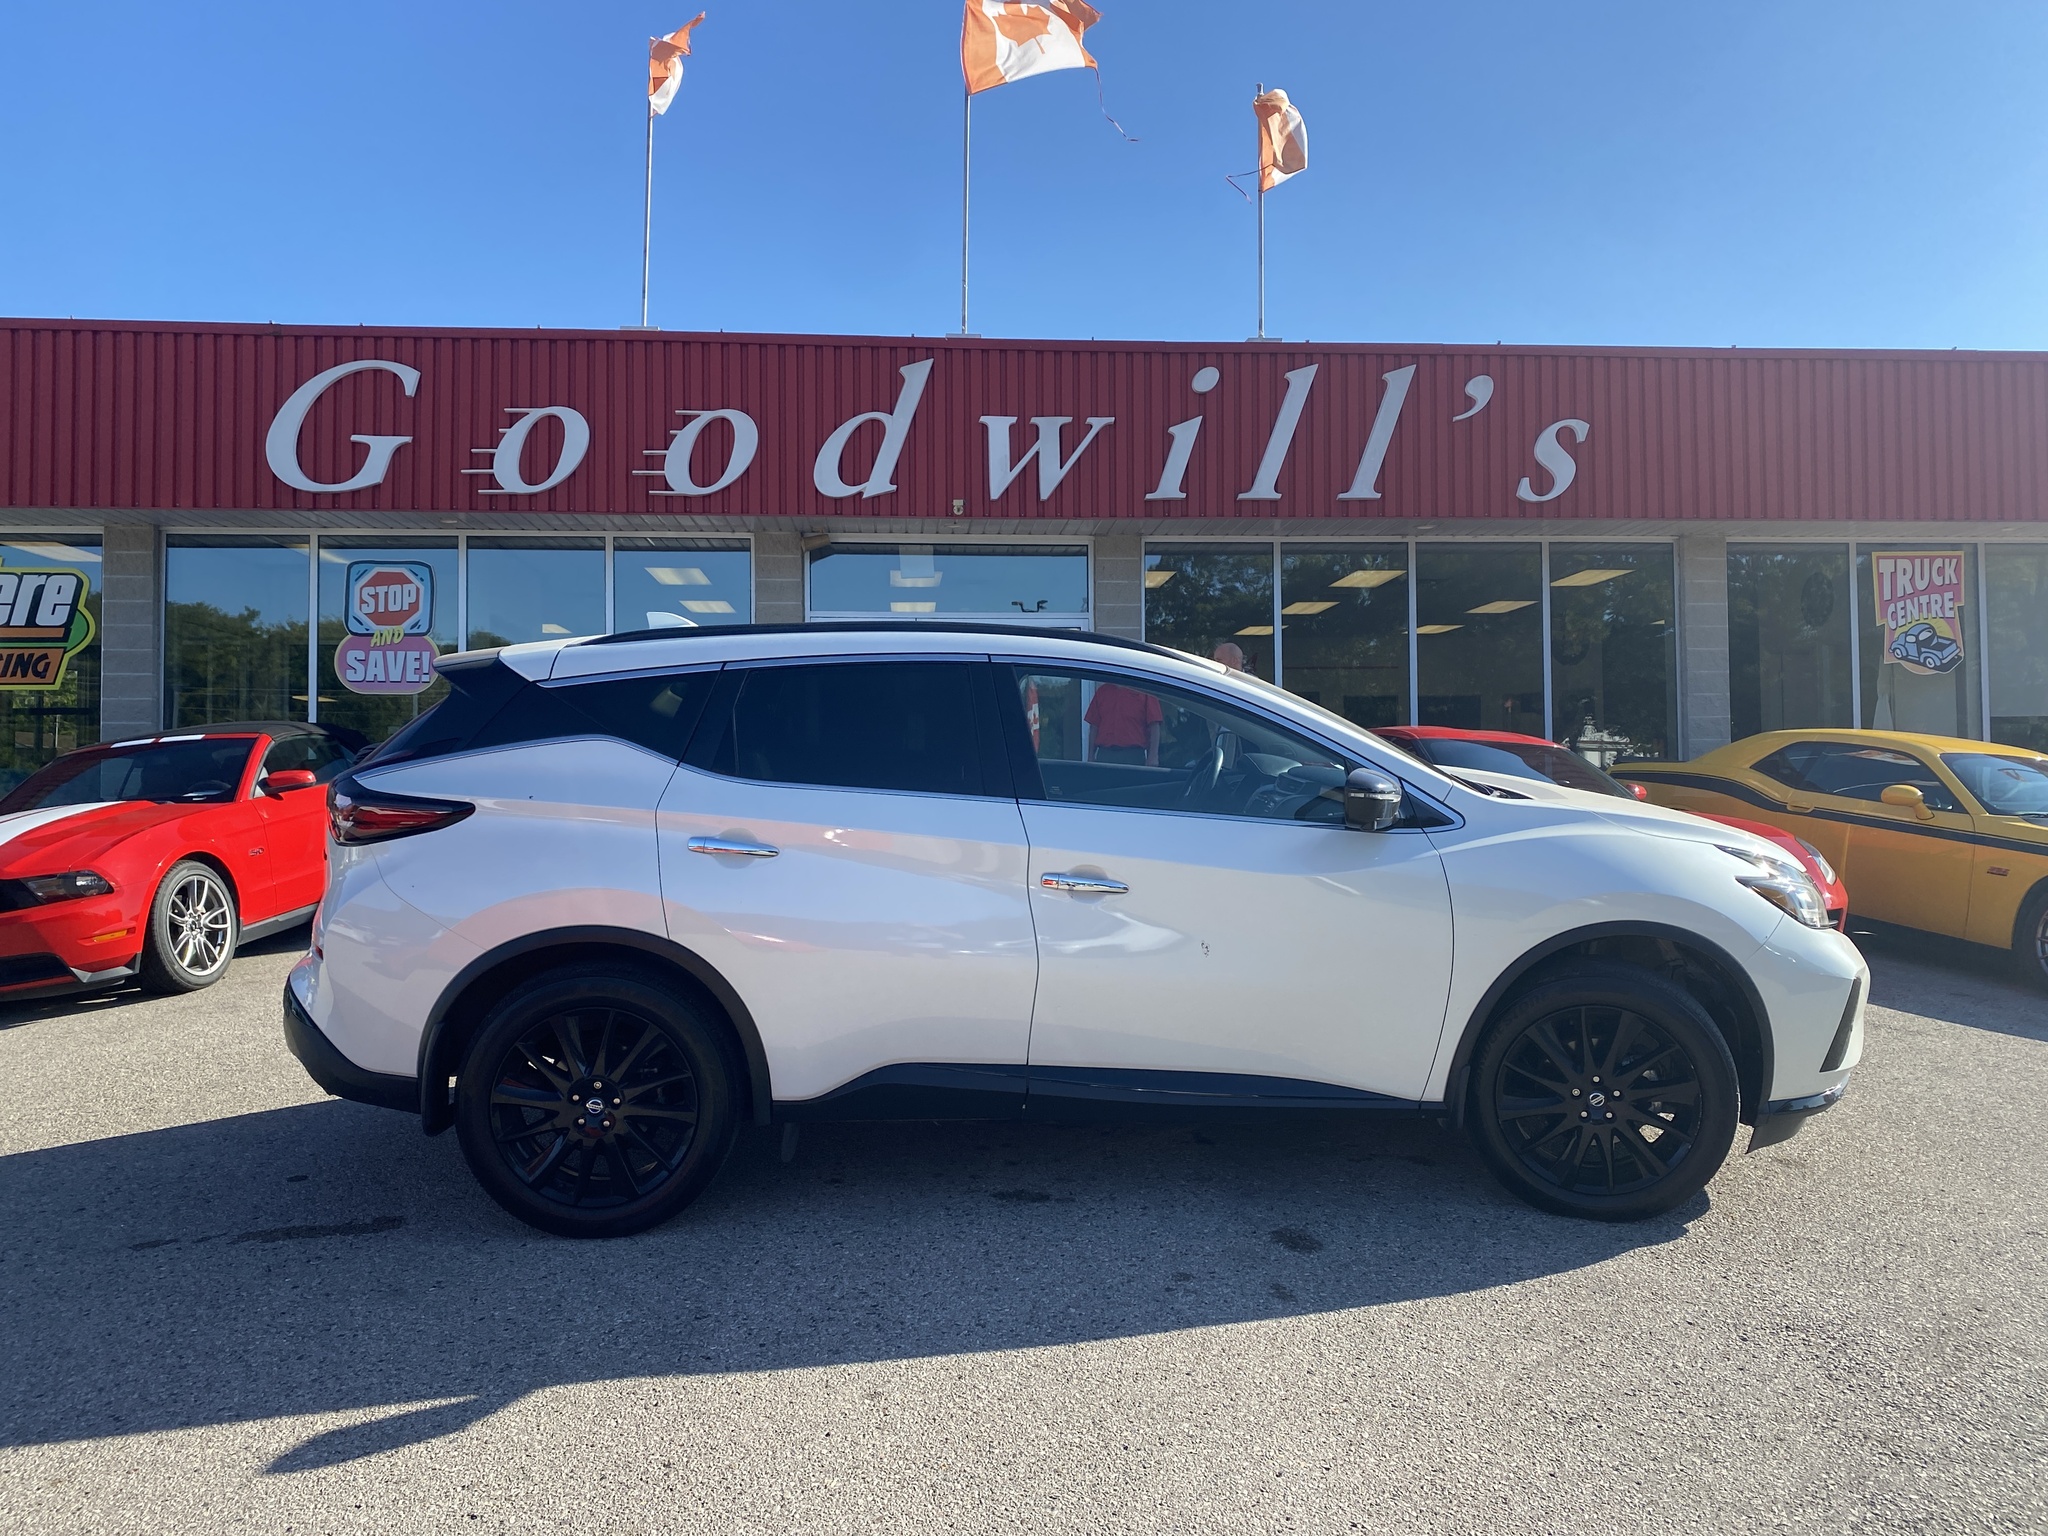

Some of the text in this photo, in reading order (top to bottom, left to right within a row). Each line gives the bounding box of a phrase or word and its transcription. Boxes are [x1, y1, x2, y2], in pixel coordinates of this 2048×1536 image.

[265, 358, 1590, 503] Goodwill's
[1878, 557, 1959, 601] TRUCK
[360, 583, 417, 614] STOP
[1887, 591, 1956, 631] CENTRE
[370, 625, 405, 647] AND
[0, 652, 52, 679] ING
[345, 649, 431, 684] SAVE!
